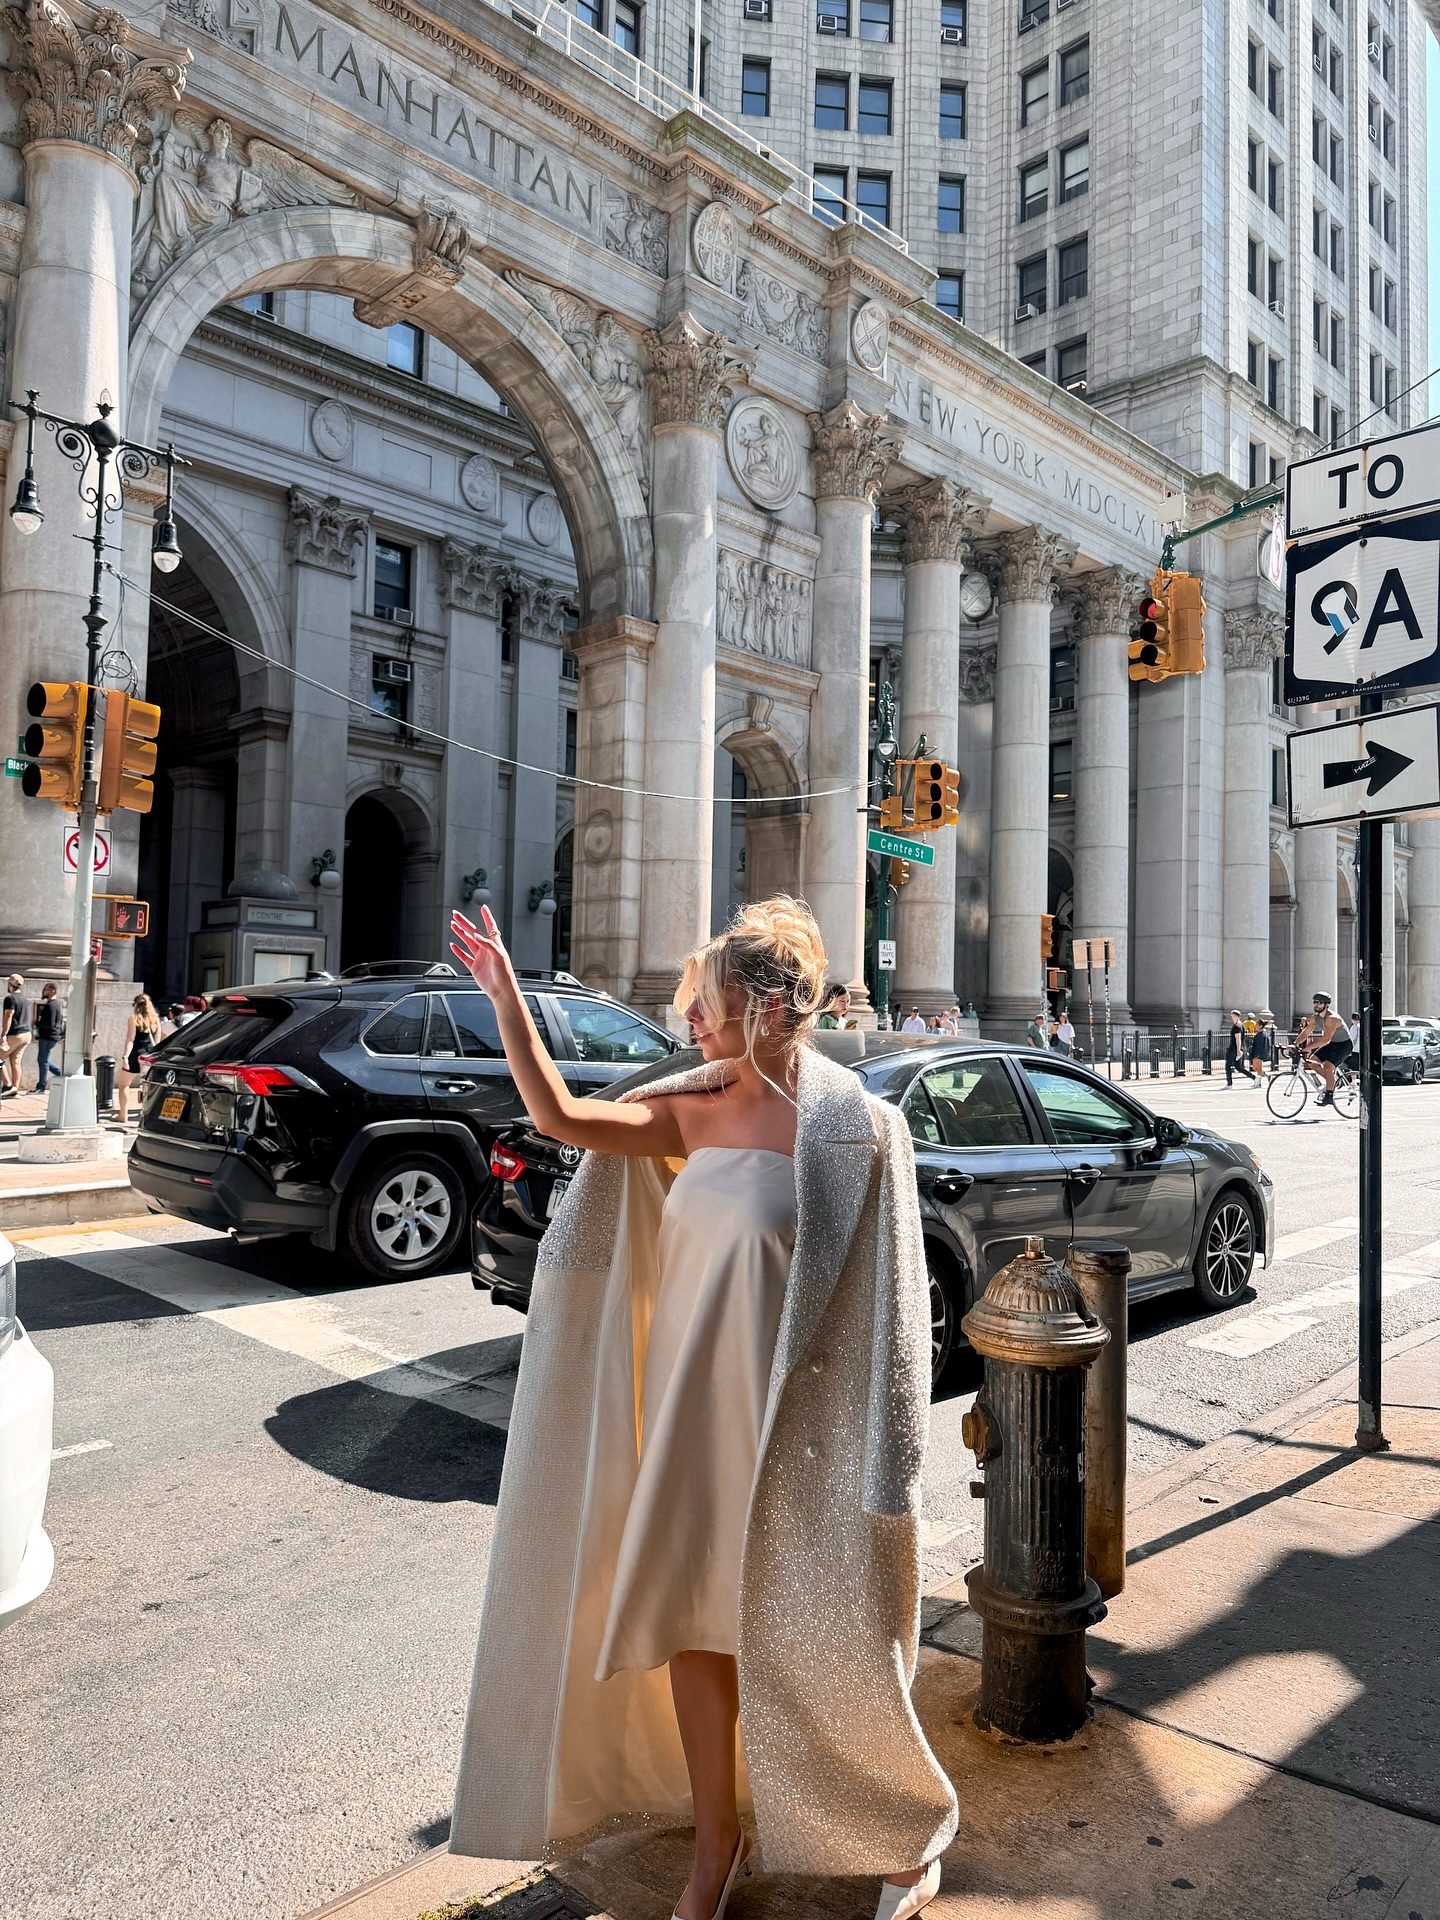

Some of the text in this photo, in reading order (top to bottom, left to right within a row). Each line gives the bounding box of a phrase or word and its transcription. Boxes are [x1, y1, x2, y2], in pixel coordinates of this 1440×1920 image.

[274, 2, 597, 224] MANHATTAN
[892, 372, 1156, 548] NEW YORK MDCLXI
[1328, 454, 1404, 510] TO
[1311, 567, 1424, 656] 9A
[880, 838, 925, 859] Centre St
